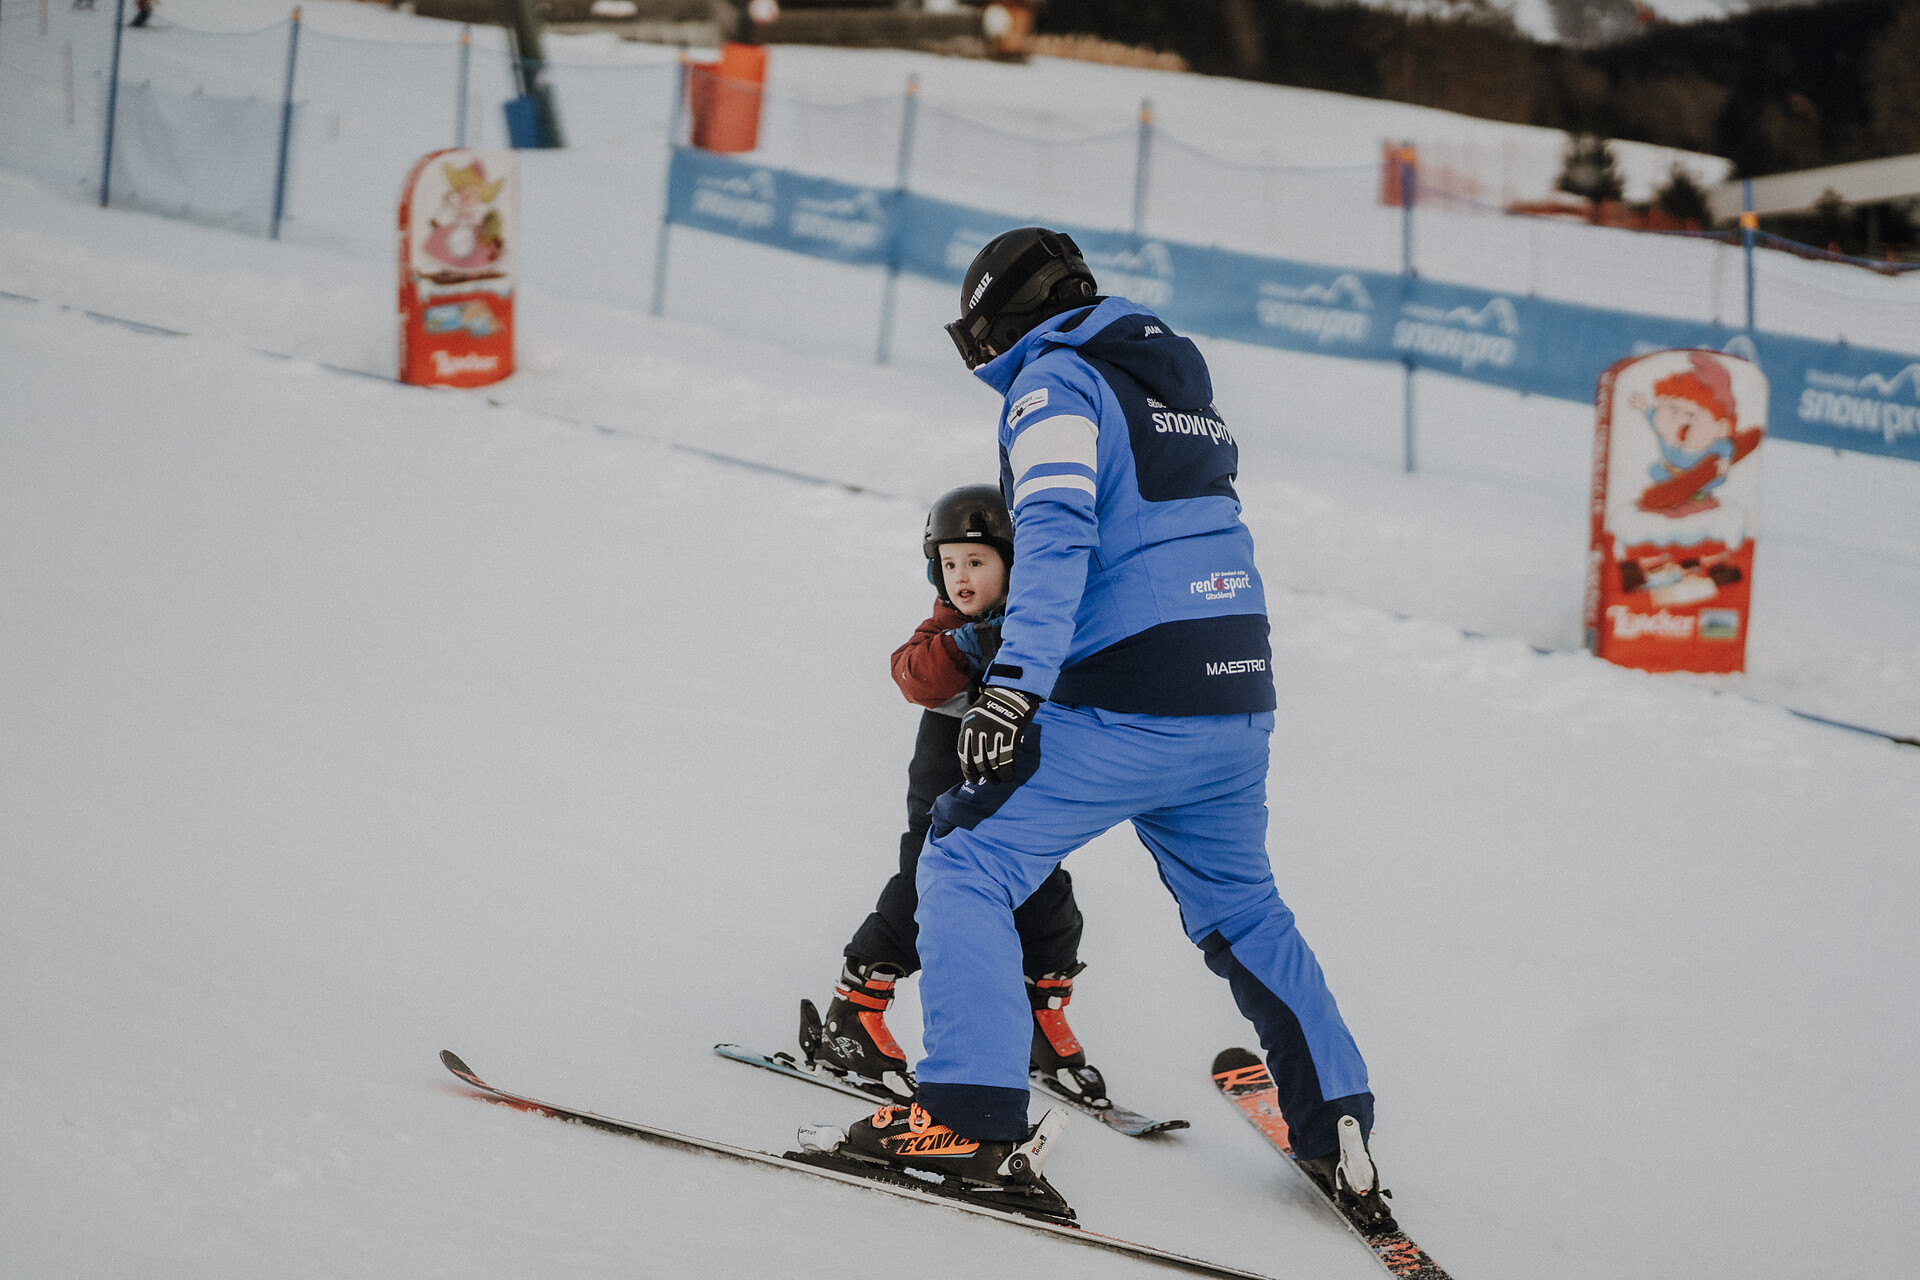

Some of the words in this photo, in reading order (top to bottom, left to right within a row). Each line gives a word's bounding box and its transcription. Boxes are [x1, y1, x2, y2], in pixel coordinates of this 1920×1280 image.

[1151, 411, 1233, 446] snowpro
[1798, 388, 1920, 443] snowpr
[1206, 659, 1266, 676] MAESTRO
[987, 700, 1018, 720] reusch
